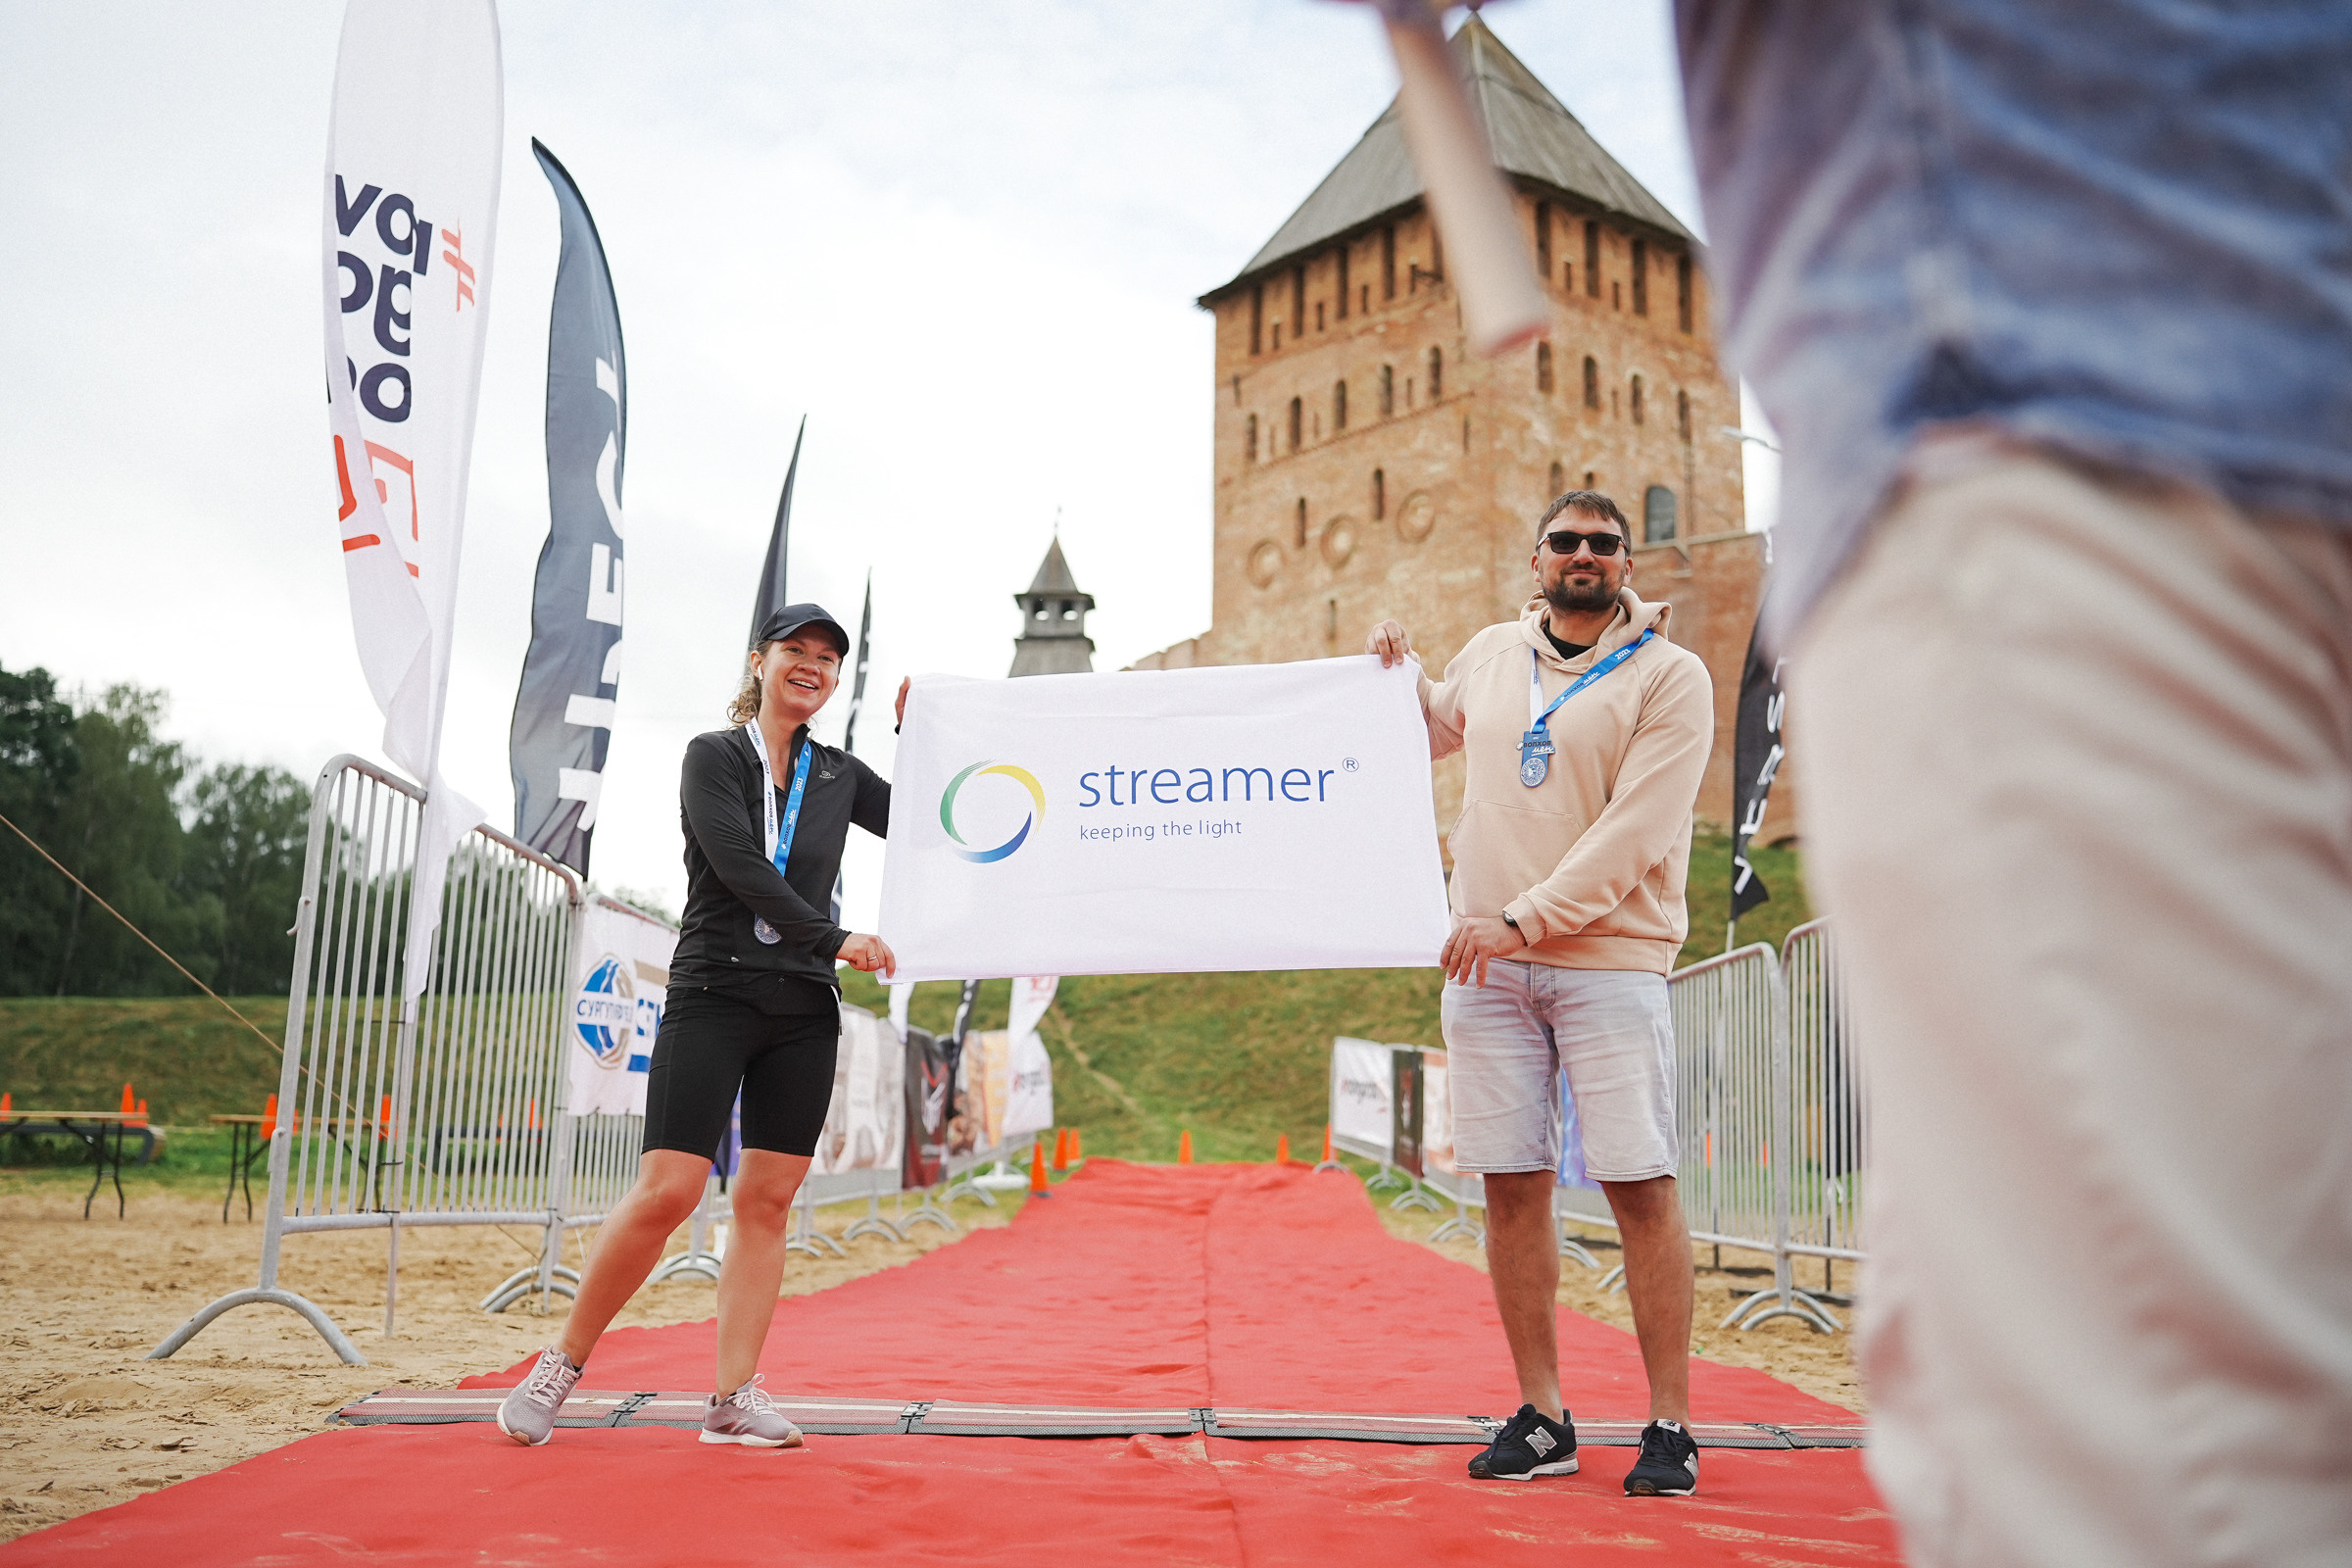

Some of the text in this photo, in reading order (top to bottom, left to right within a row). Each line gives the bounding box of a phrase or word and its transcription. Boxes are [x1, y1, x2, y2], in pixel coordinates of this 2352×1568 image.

[1079, 764, 1335, 808] streamer
[1080, 819, 1243, 842] keeping the light
